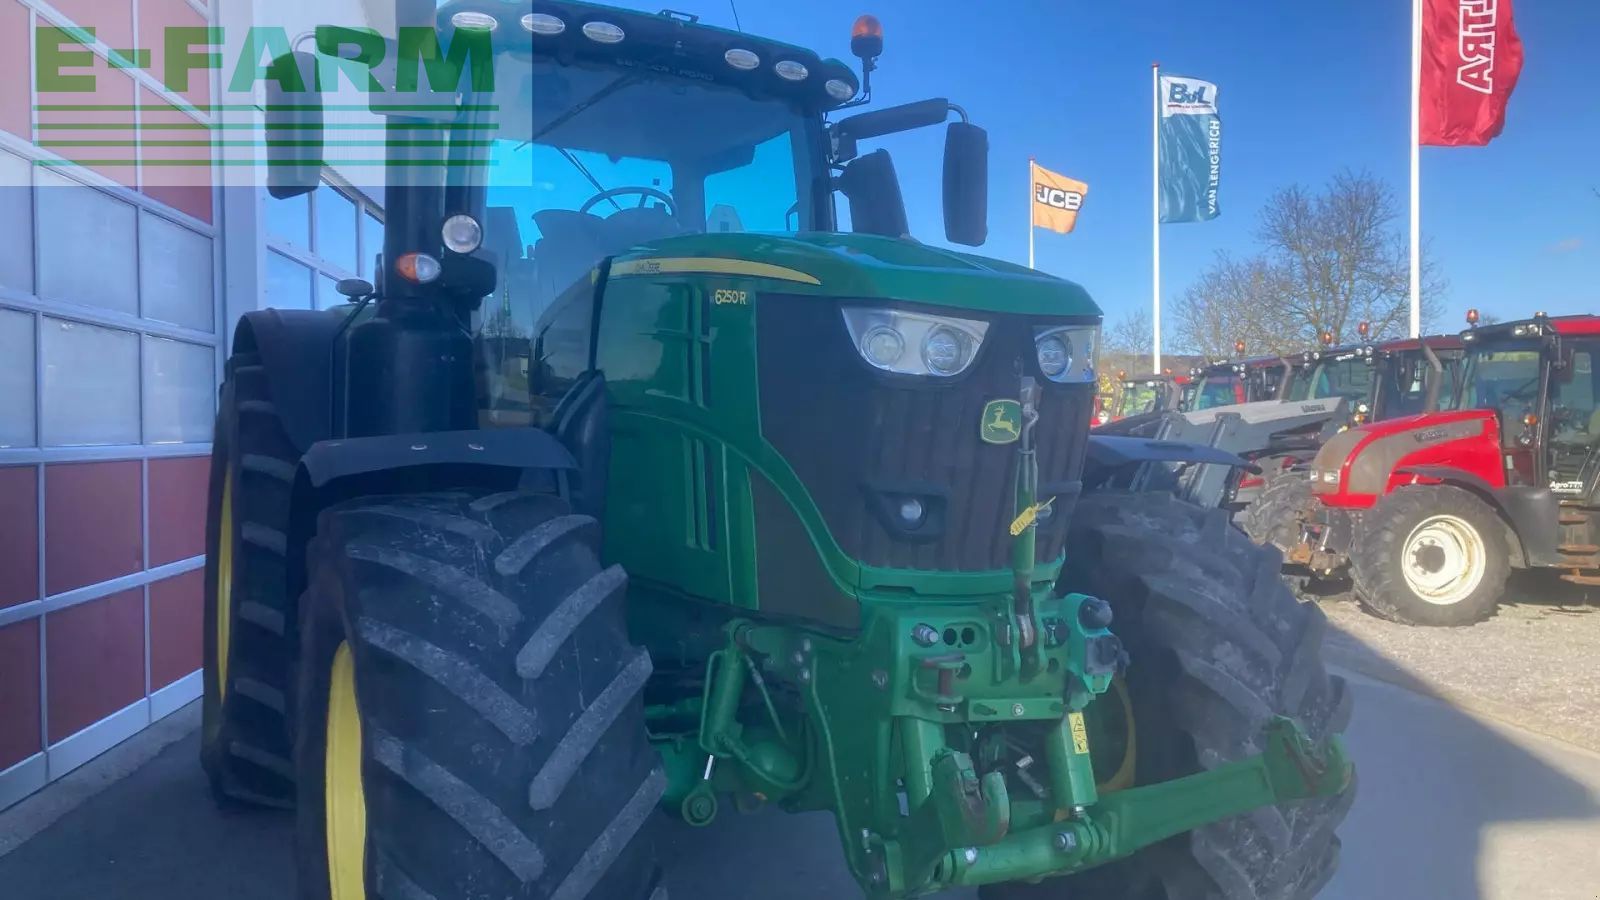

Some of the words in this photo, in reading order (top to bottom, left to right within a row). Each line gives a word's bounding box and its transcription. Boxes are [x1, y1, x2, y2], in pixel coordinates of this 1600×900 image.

[1209, 120, 1221, 186] LENGERICH
[1036, 186, 1082, 210] JCB
[1209, 189, 1217, 214] VAN
